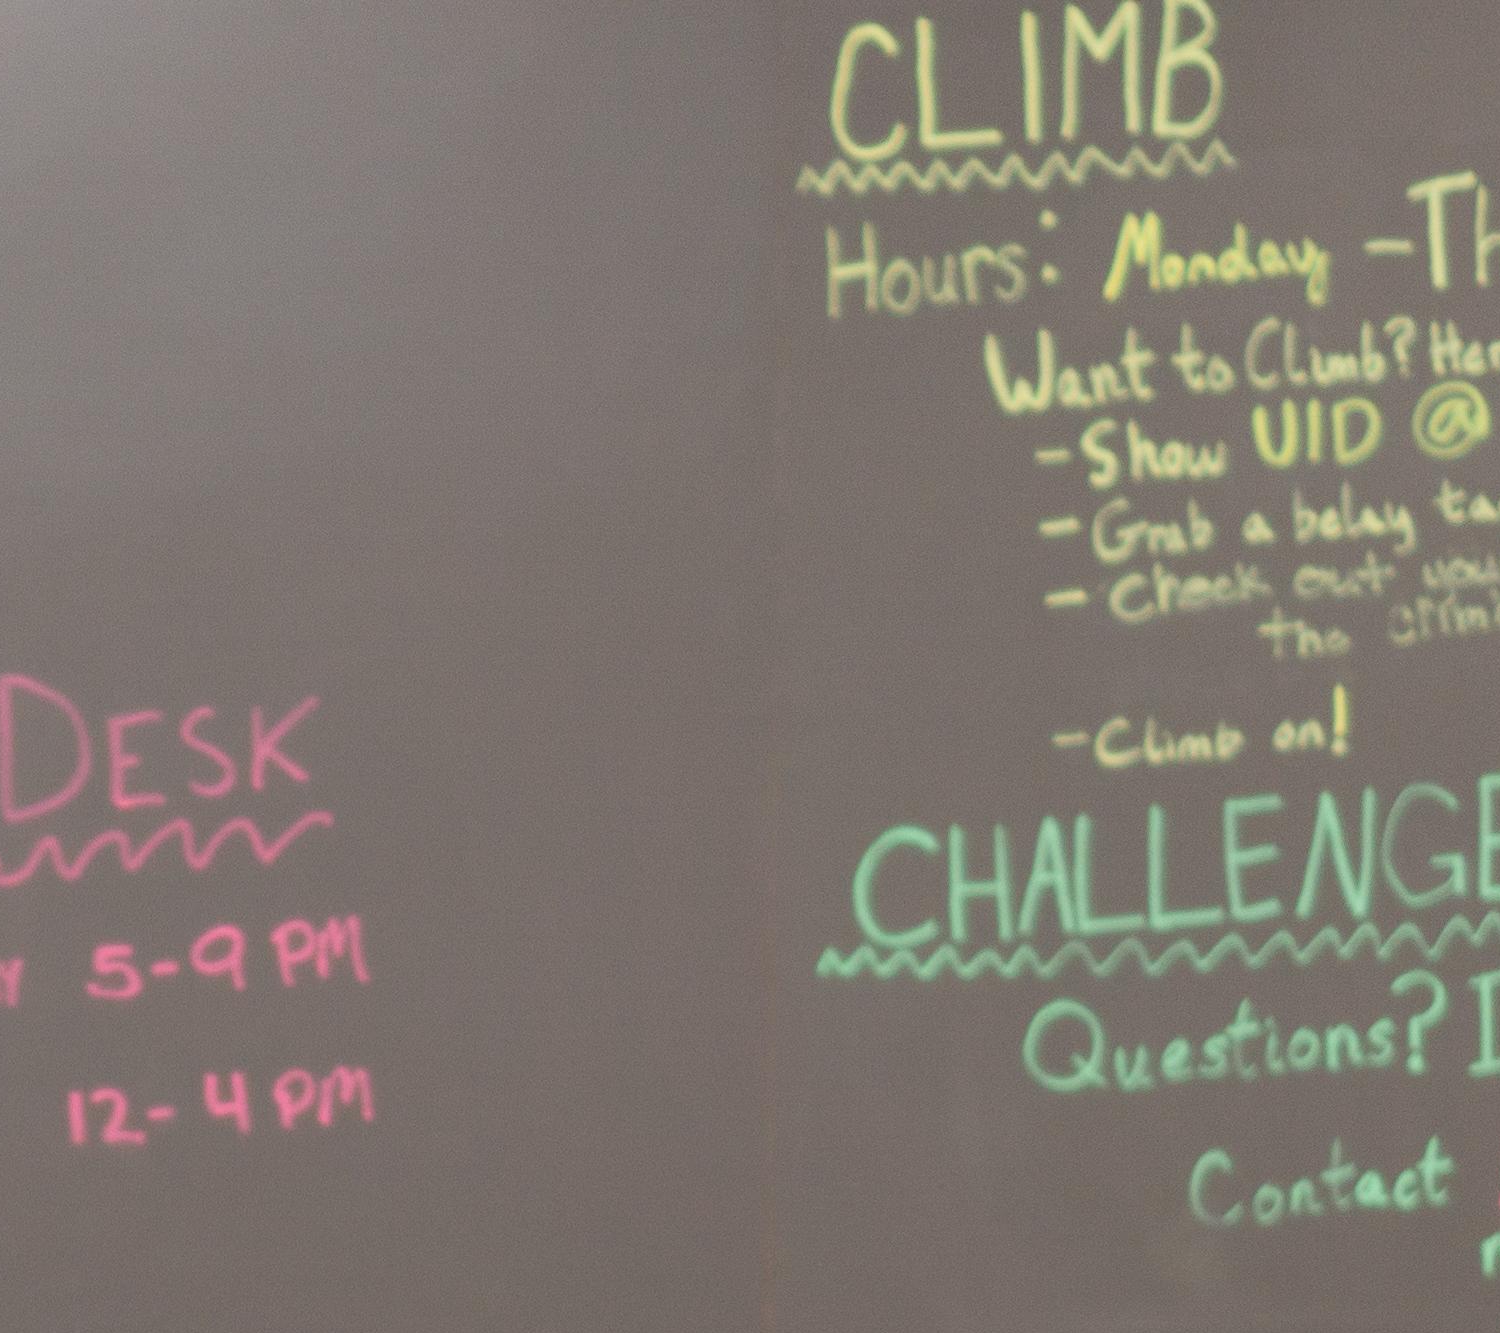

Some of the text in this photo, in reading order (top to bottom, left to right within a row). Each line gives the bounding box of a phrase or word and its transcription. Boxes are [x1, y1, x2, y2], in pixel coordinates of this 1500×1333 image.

[828, 0, 1227, 160] CLIMB
[826, 210, 1061, 318] Hours:
[1103, 211, 1332, 306] Monday
[983, 327, 1155, 413] Want
[1170, 325, 1235, 394] to
[1243, 317, 1417, 388] Climb?
[1252, 396, 1384, 468] UID
[1411, 380, 1493, 459] @
[1241, 512, 1276, 544] a
[1292, 481, 1418, 556] belay
[1273, 683, 1350, 756] on!
[271, 914, 370, 988] PM
[1022, 968, 1449, 1093] Questions?
[274, 1067, 375, 1127] PM
[1187, 1135, 1455, 1228] Contact
